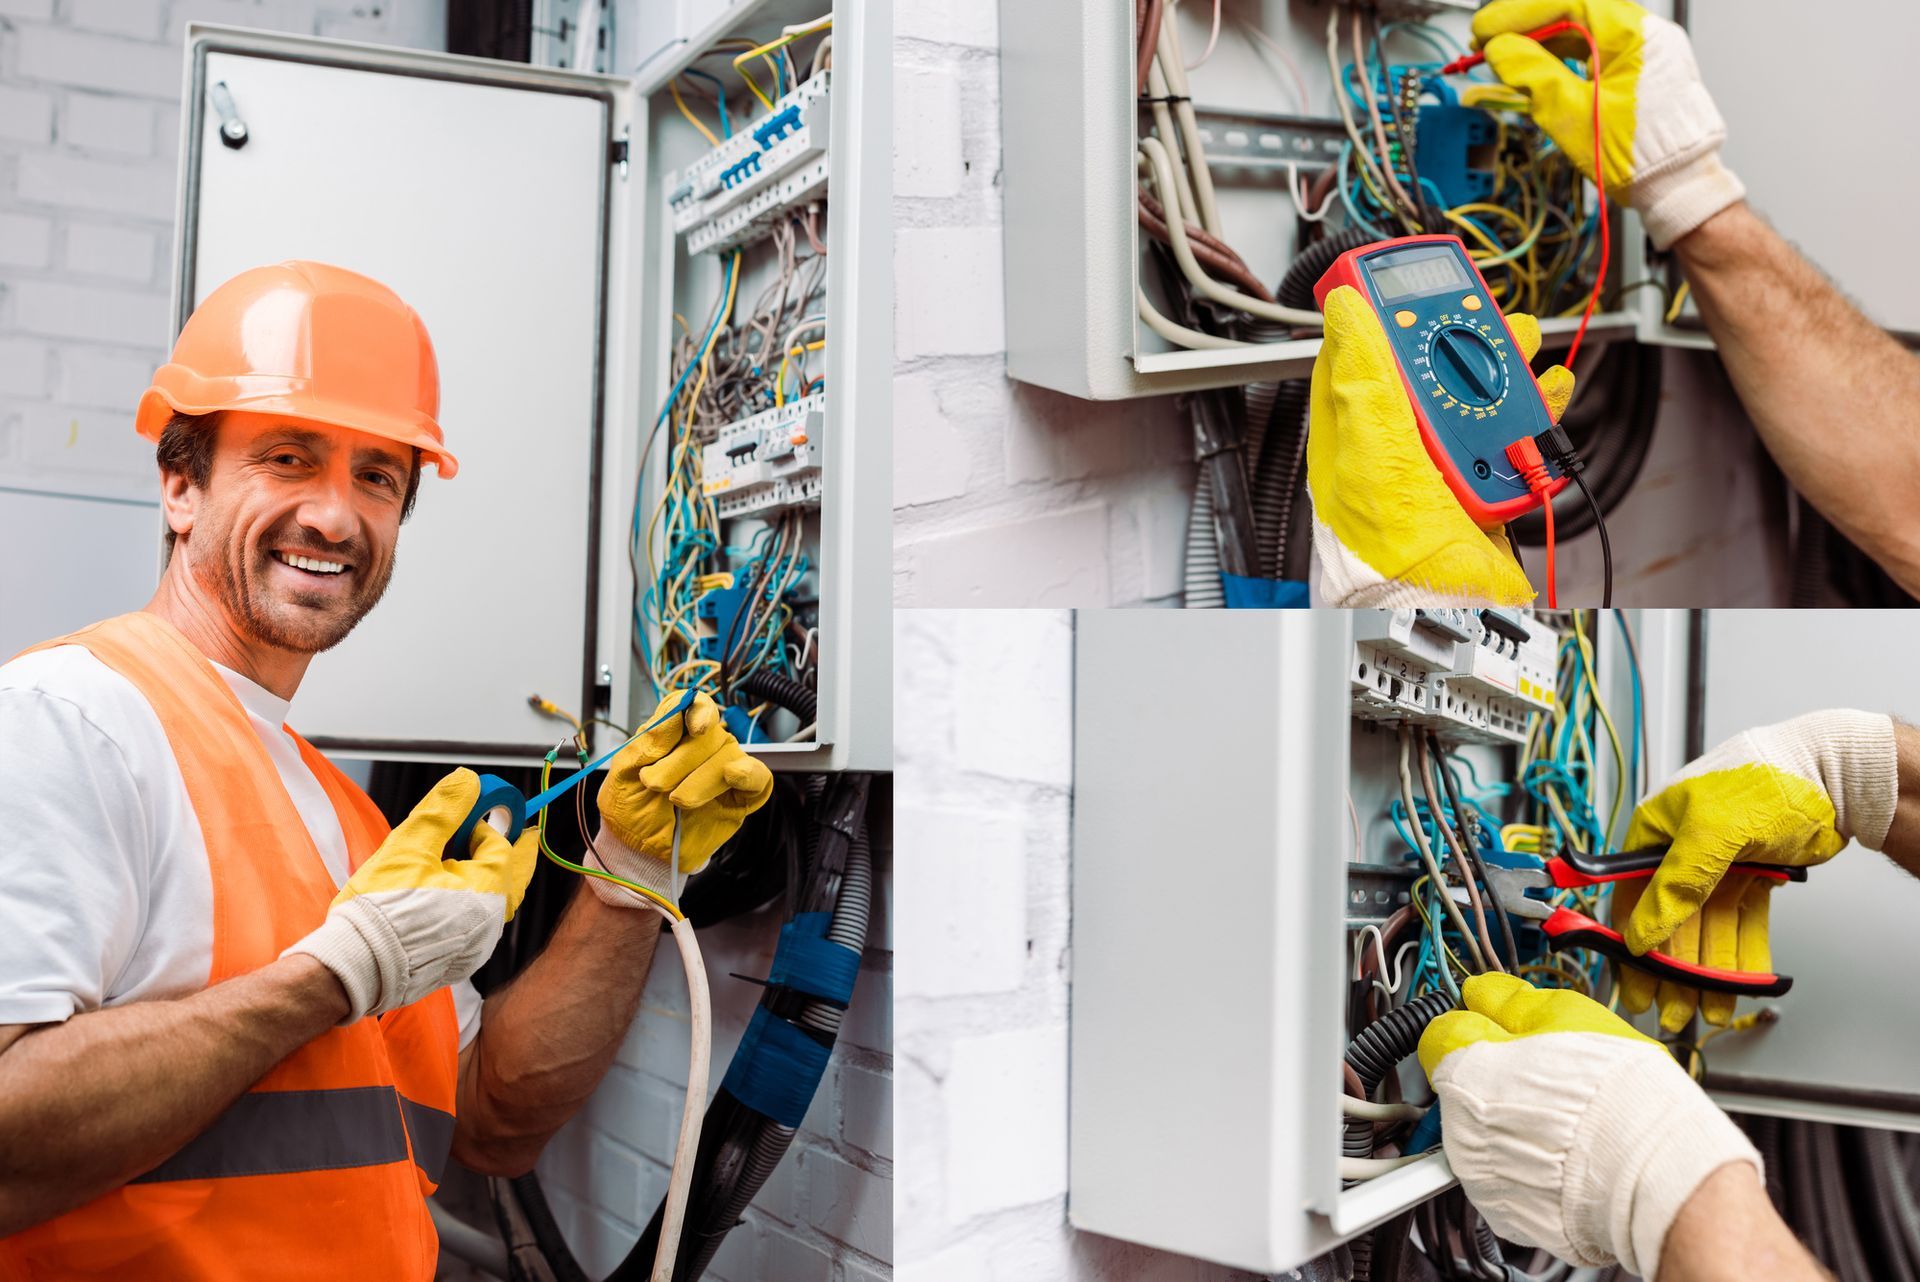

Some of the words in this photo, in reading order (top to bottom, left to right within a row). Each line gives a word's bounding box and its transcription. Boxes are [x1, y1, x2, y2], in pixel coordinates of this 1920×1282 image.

[1440, 313, 1449, 321] OFF
[1383, 656, 1389, 669] 1
[1400, 663, 1407, 677] 2
[1416, 671, 1426, 684] 3
